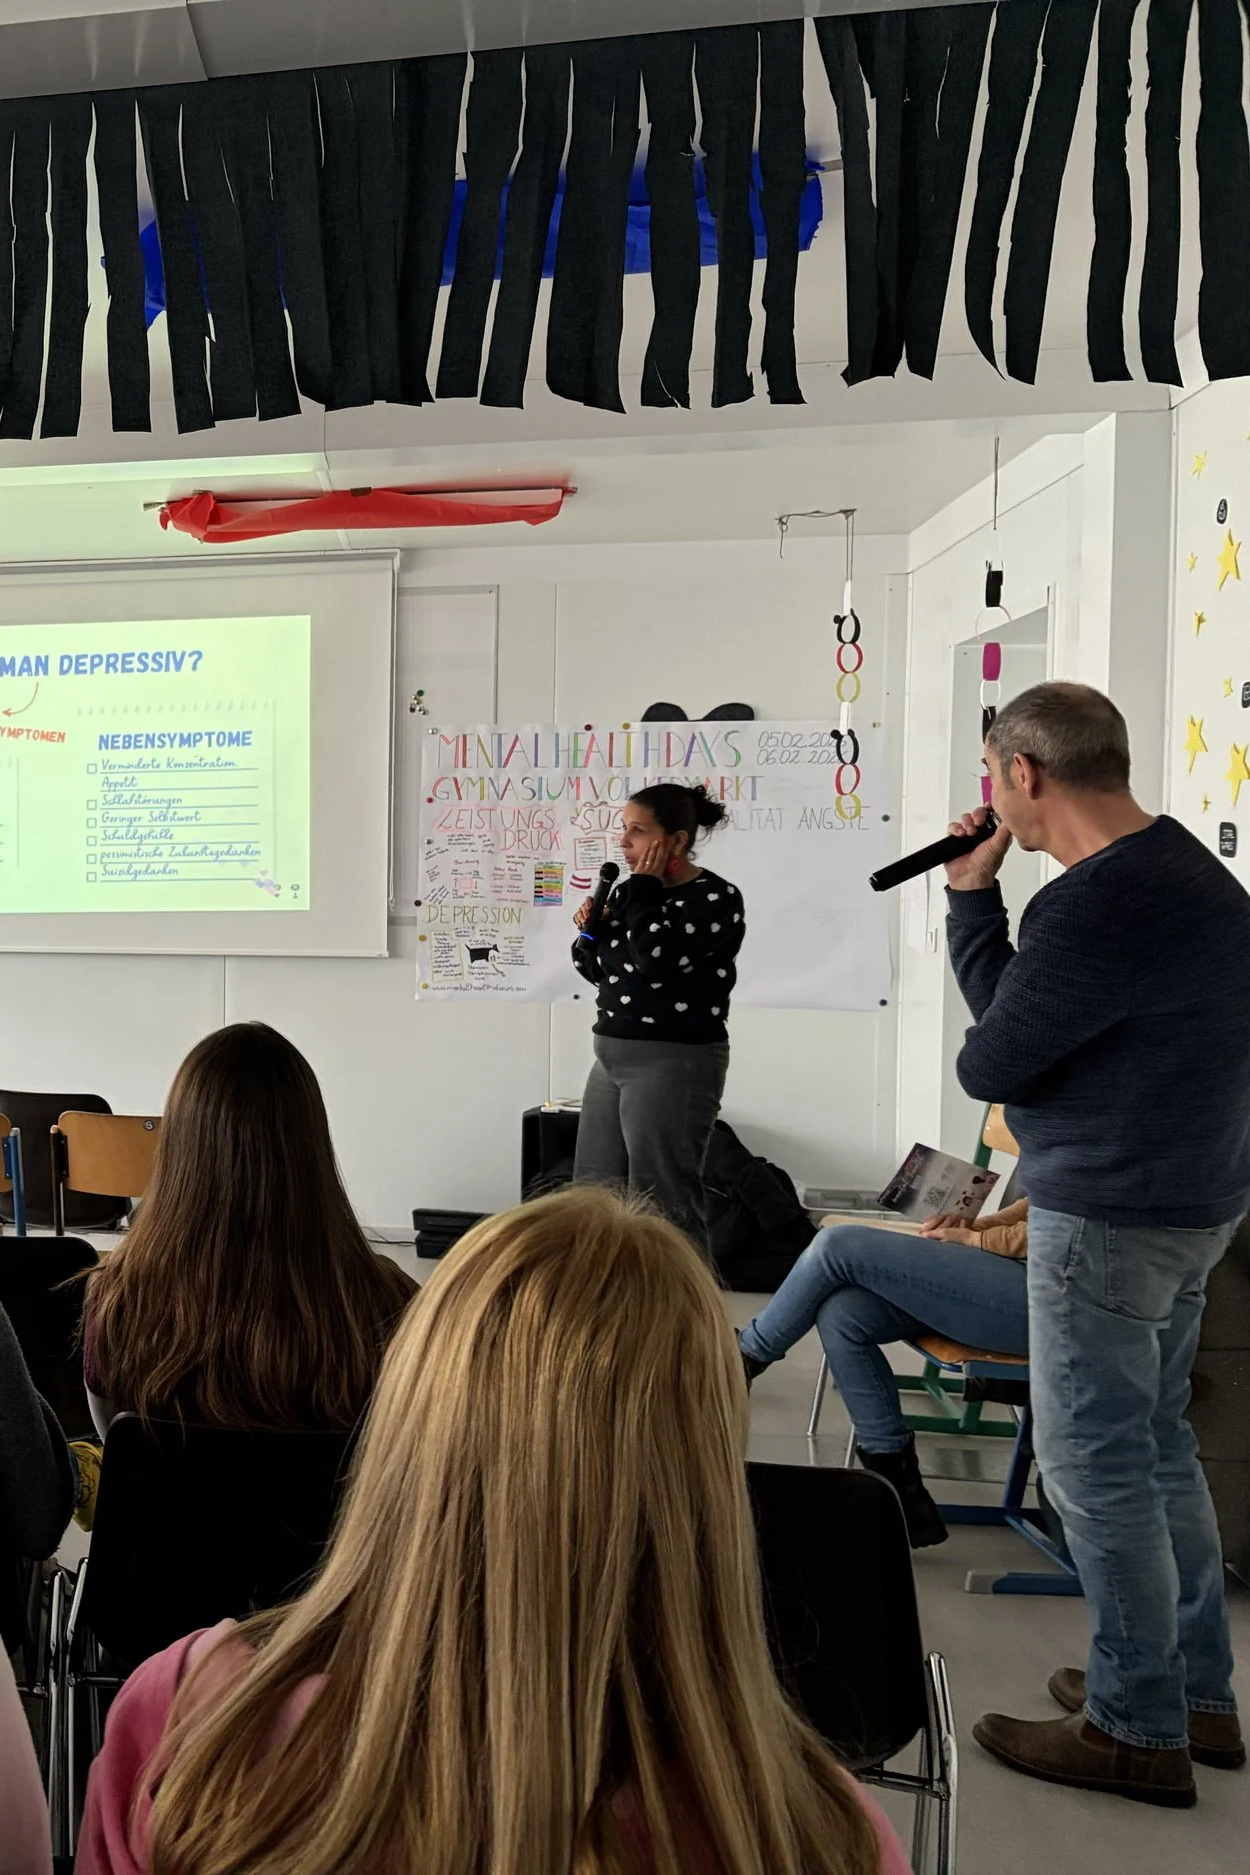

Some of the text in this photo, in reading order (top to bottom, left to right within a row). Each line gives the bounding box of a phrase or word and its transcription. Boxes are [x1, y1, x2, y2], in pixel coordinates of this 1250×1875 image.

[58, 650, 203, 676] DEPRESSIV?
[97, 730, 253, 751] NEBENSYMPTOME
[101, 757, 162, 771] Verminderte
[102, 775, 138, 793] Appetit
[432, 776, 580, 801] GYMNASIUM
[101, 792, 183, 810] Schlafstörungen
[101, 810, 202, 828] Geringer Selbstwert
[101, 828, 174, 848] Schuldgefühle
[500, 829, 560, 852] DRUCK
[100, 845, 261, 864] pessimistische Zukunftsgedanken
[101, 864, 179, 880] Suizidgedanken
[427, 905, 521, 926] DEPRESSION
